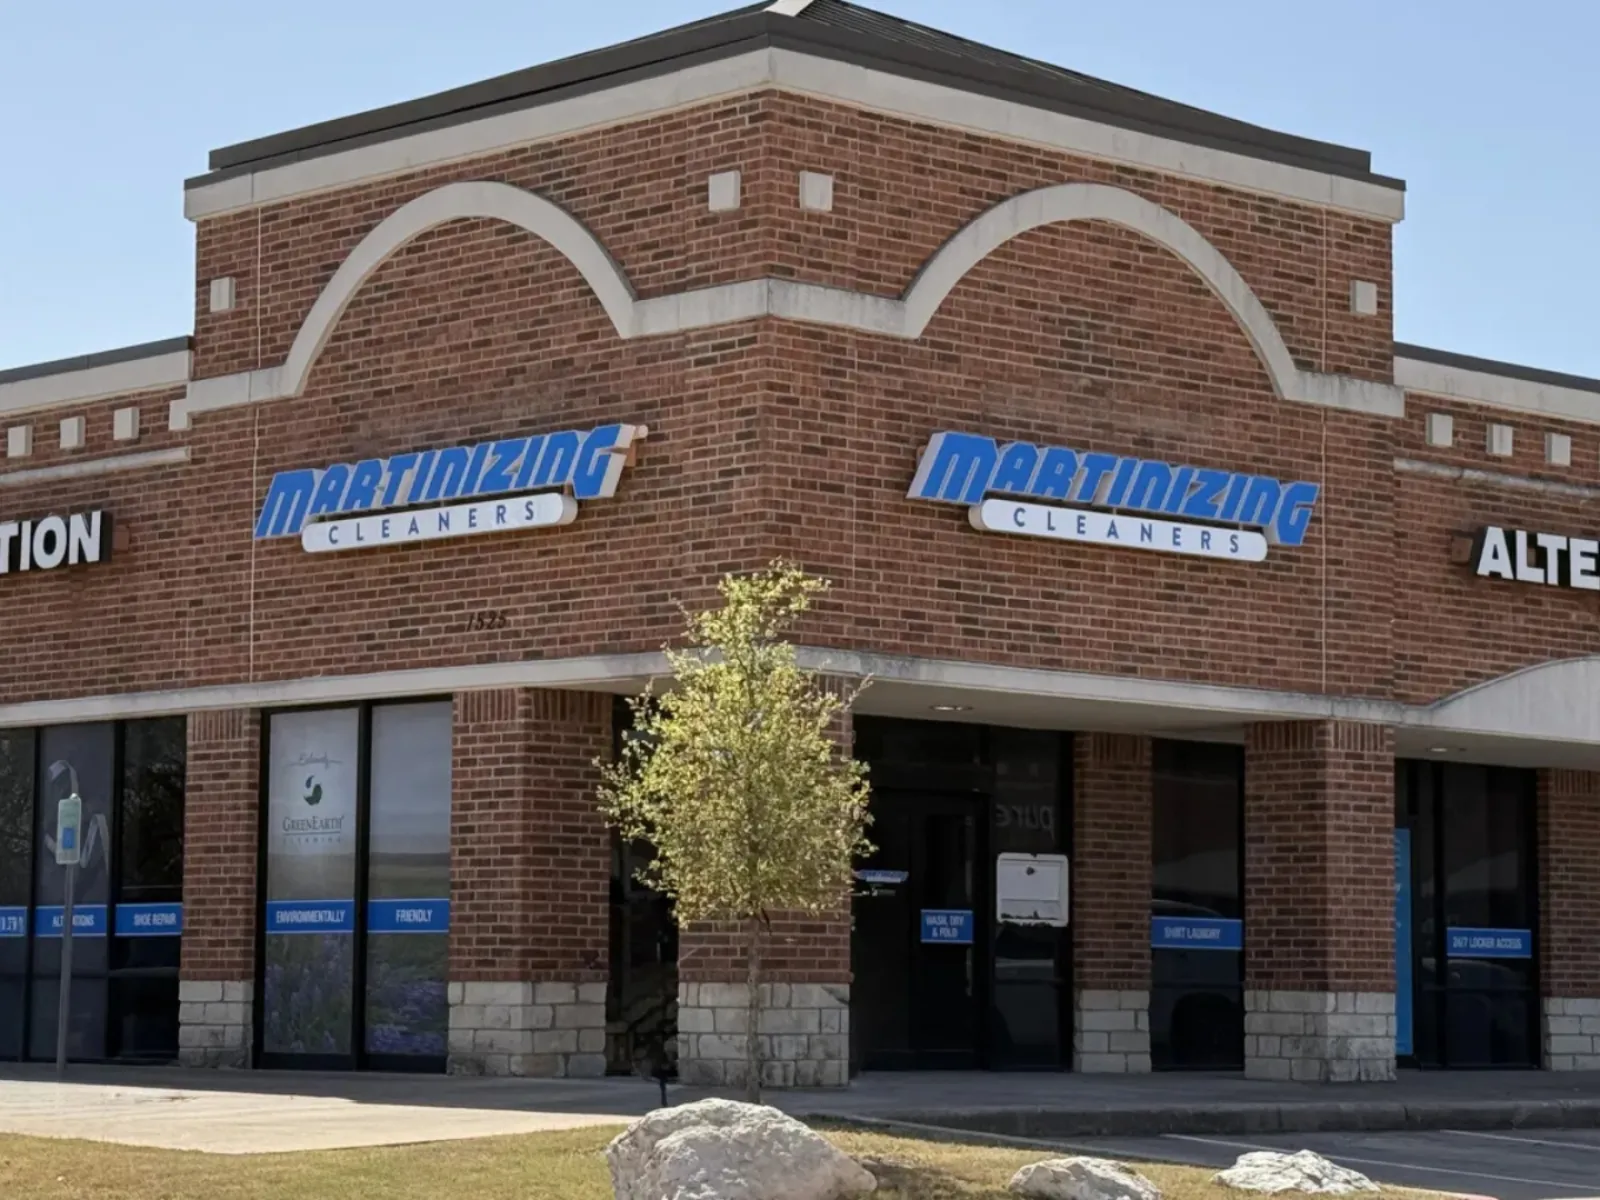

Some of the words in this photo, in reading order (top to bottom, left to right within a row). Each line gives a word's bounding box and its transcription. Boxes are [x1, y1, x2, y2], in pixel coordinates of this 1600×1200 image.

[255, 424, 629, 538] MARTINIZING
[914, 431, 1320, 546] MARTINIZING
[0, 510, 101, 574] TION
[328, 501, 534, 545] CLEANERS
[1013, 507, 1240, 553] CLEANERS
[1477, 526, 1600, 590] ALTE
[467, 610, 506, 632] 1525
[276, 910, 346, 923] ENVIRONMENTALLY
[395, 909, 433, 922] FRIENDLY
